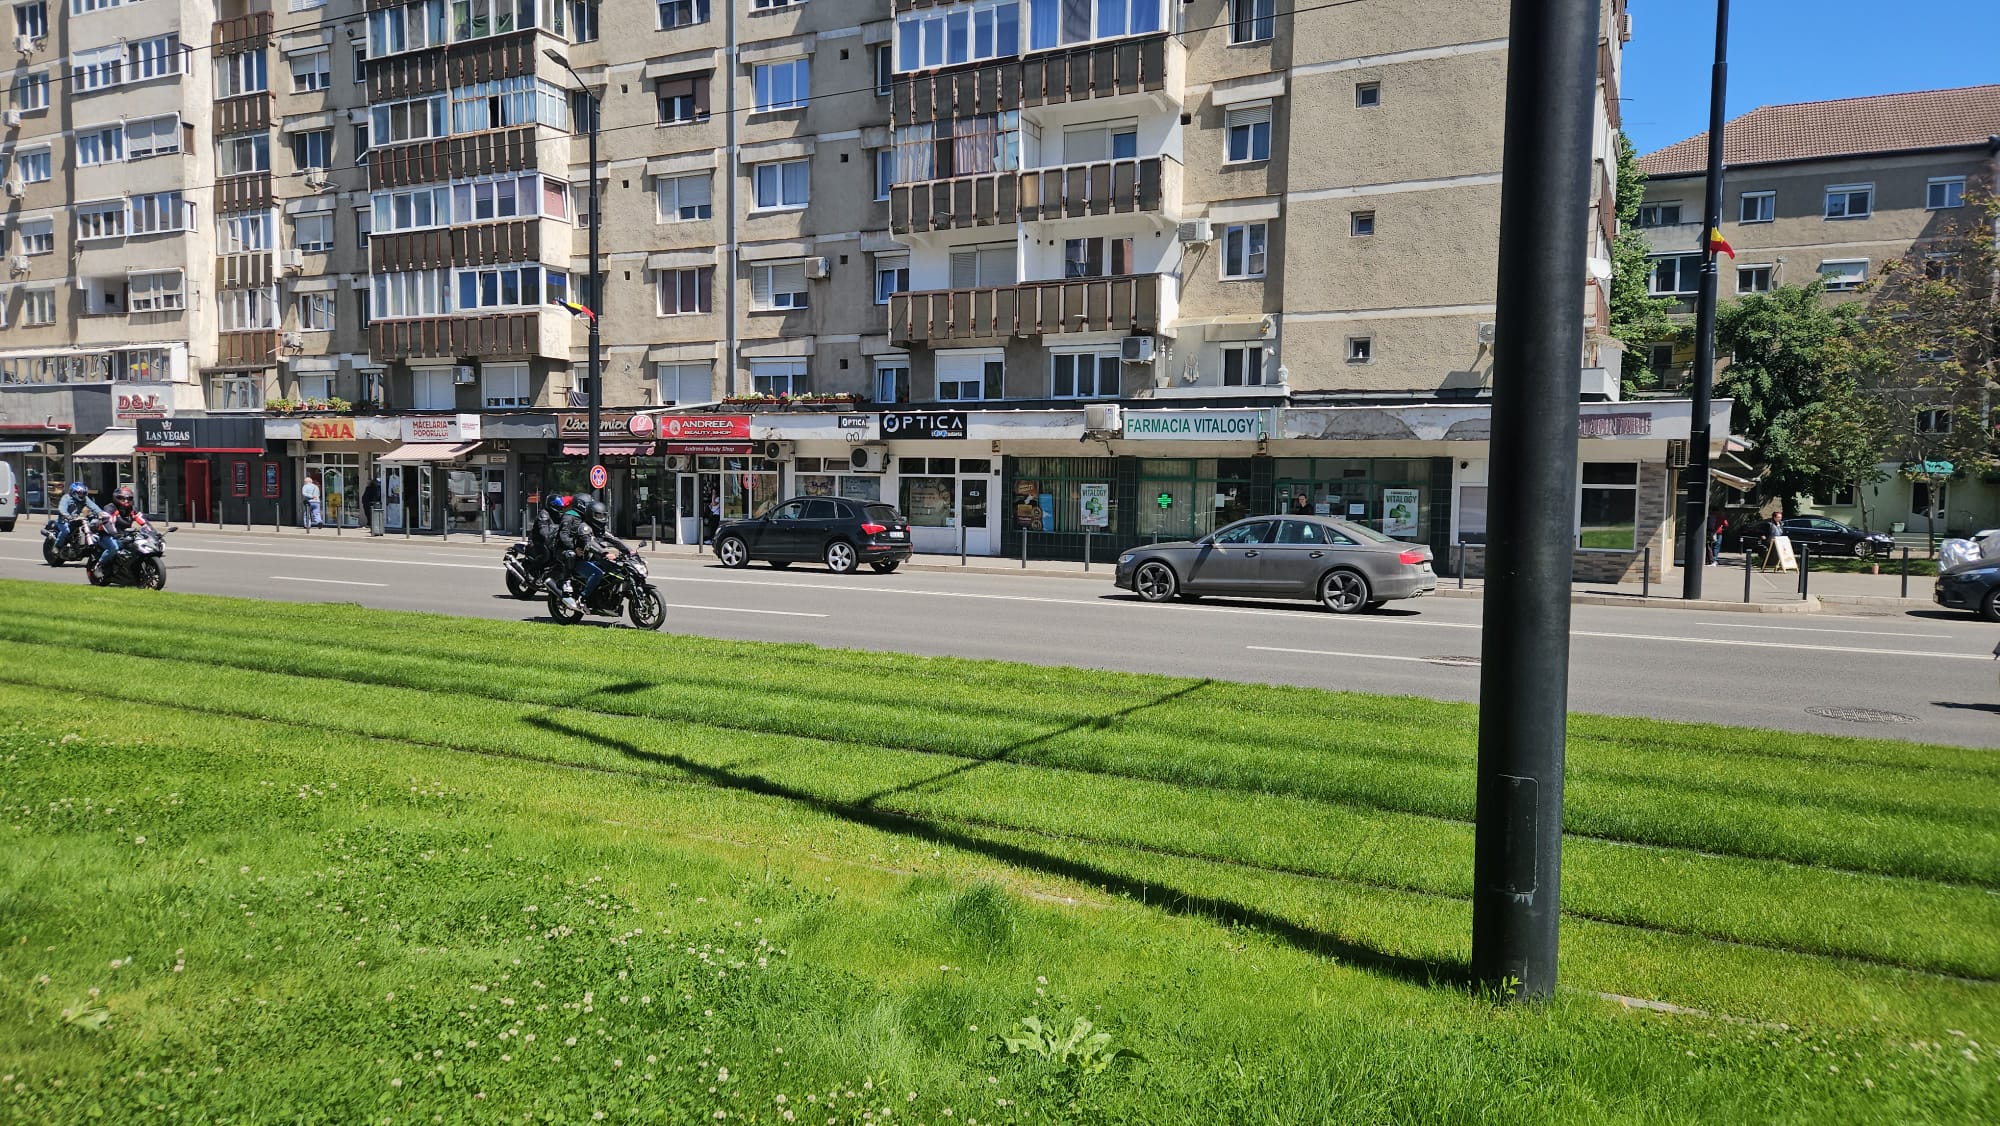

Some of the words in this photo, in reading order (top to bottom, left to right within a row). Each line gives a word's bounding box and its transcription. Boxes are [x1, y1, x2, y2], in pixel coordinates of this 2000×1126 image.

[682, 420, 734, 428] ANDREEA
[842, 418, 866, 427] OPTICA
[883, 414, 963, 433] OPTICA
[1127, 418, 1191, 433] FARMACIA
[1194, 418, 1255, 433] VITALOGY
[145, 431, 162, 440] LAS
[163, 431, 190, 440] VEGAS
[309, 423, 354, 438] AMA
